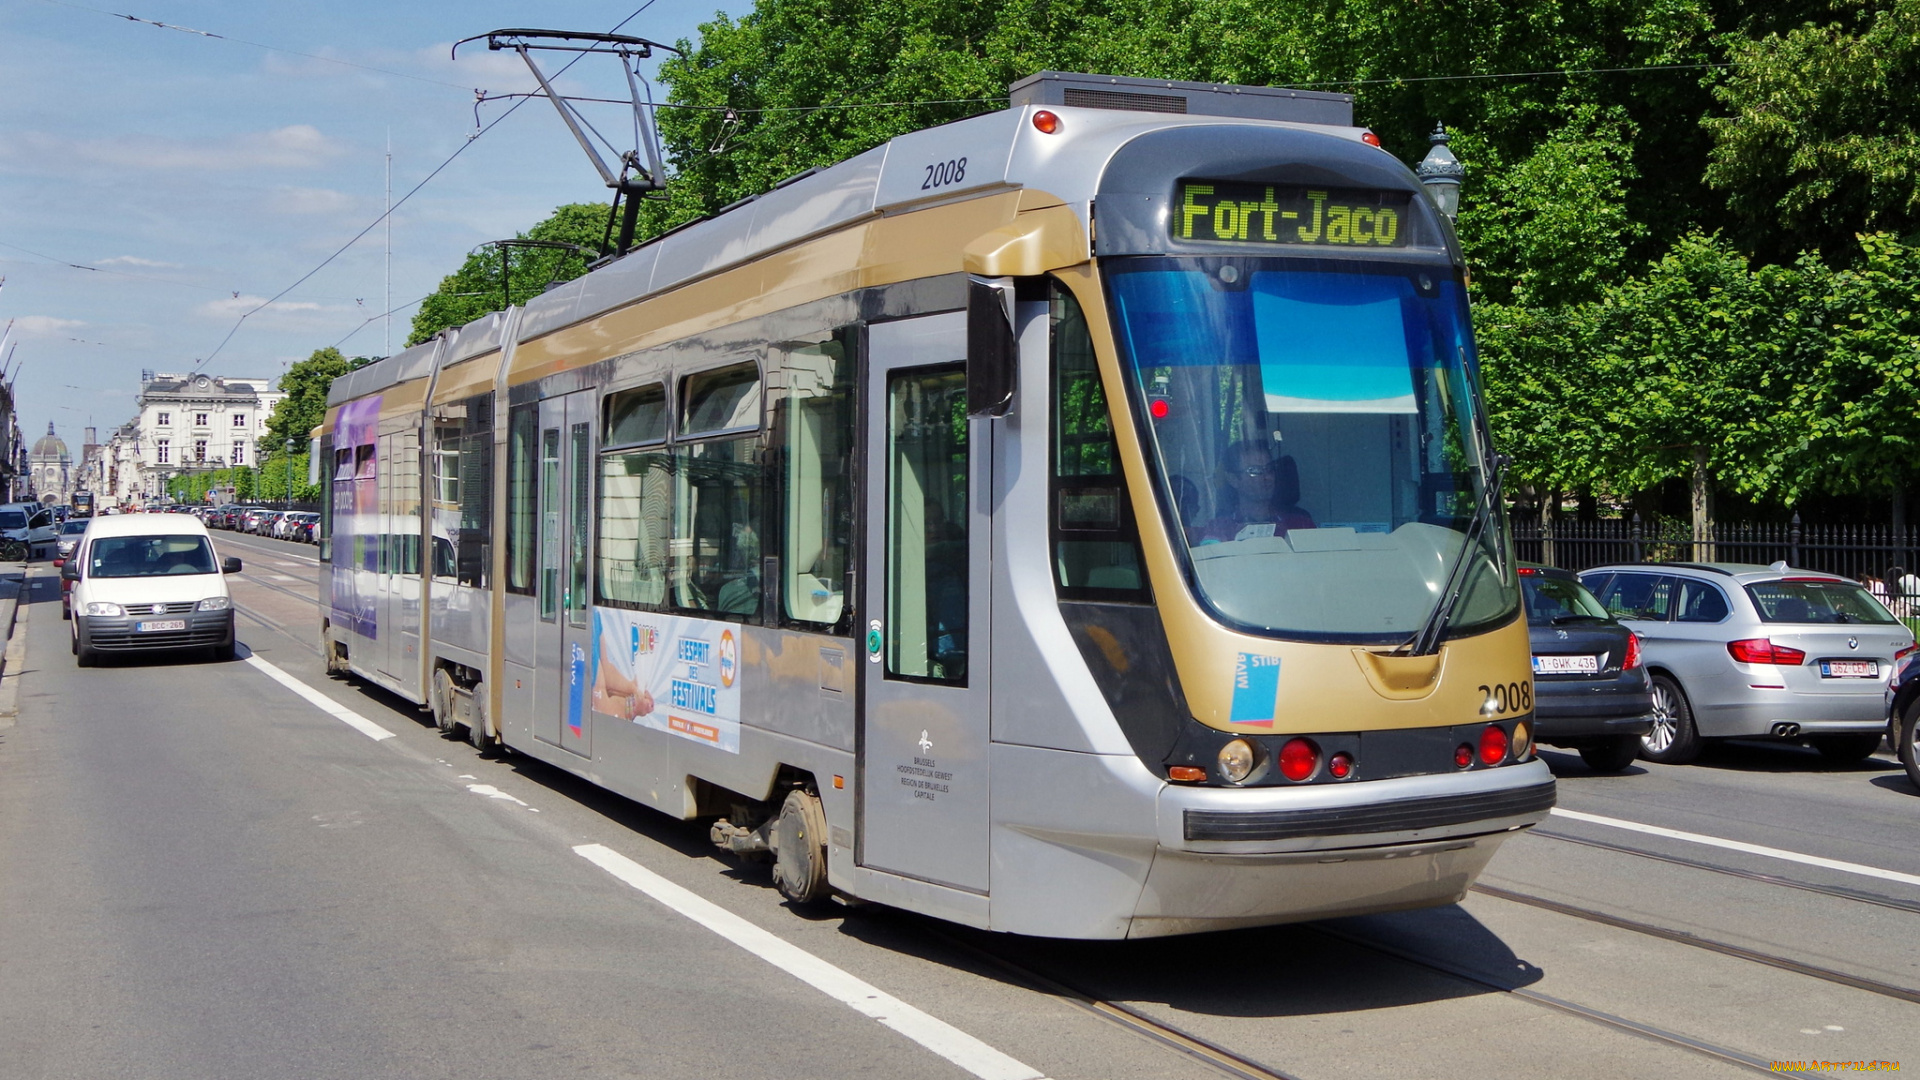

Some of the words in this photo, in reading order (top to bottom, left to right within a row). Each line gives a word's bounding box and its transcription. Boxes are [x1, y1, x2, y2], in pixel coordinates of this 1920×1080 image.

[921, 157, 967, 191] 2008
[1183, 184, 1398, 245] Fort-Jaco
[678, 639, 710, 665] L'ESPRIT
[1251, 655, 1280, 668] STIB
[689, 665, 698, 680] DES
[1237, 653, 1249, 689] MIVB
[671, 679, 717, 715] FESTIVALS
[1478, 680, 1531, 716] 2008
[896, 765, 934, 779] HOOFDSTEDELIJK
[934, 770, 953, 781] GEWEST
[914, 757, 936, 768] BRUSSELS
[914, 789, 935, 801] CAPITALE
[918, 780, 924, 789] DE
[925, 782, 949, 793] BRUXELLES
